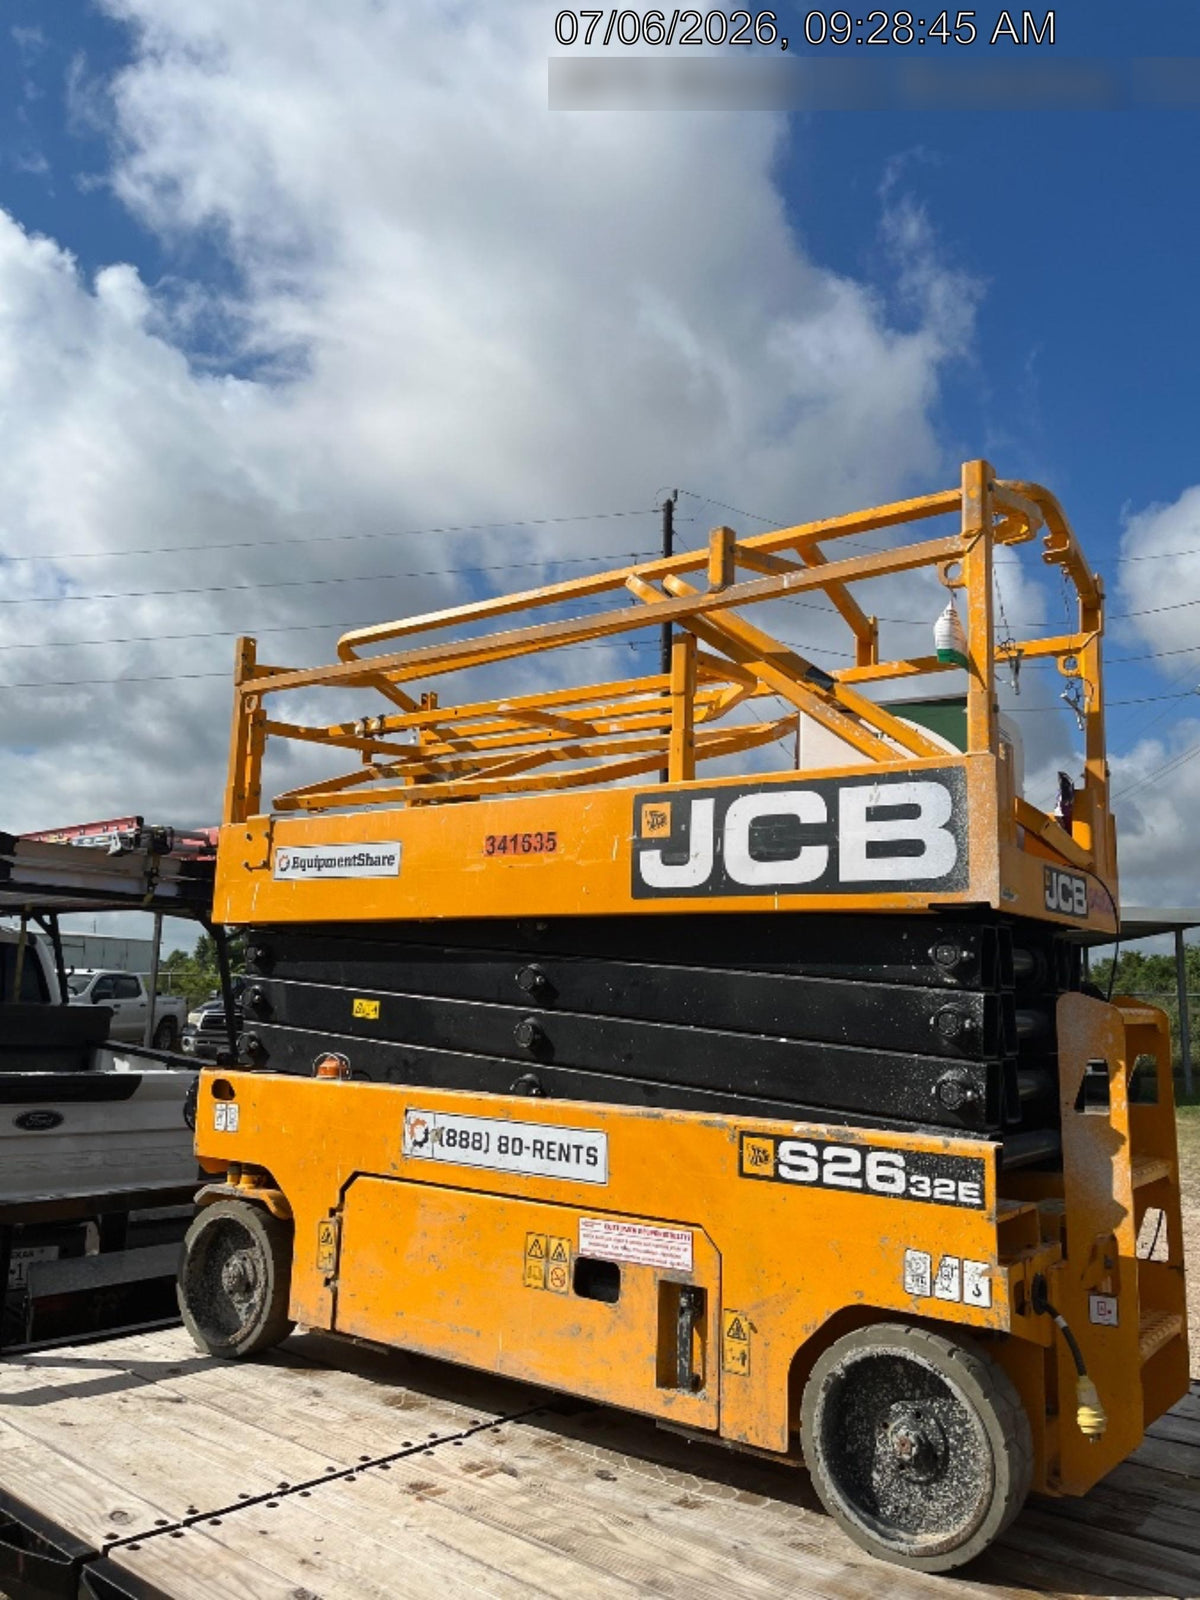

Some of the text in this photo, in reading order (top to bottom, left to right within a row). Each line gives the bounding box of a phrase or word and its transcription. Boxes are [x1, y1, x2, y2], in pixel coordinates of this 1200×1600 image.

[485, 831, 558, 855] 341635
[639, 780, 958, 890] JCB
[291, 853, 396, 872] EquipmentShare
[1045, 871, 1088, 915] JCB
[438, 1126, 599, 1167] (888) 80-RENTS
